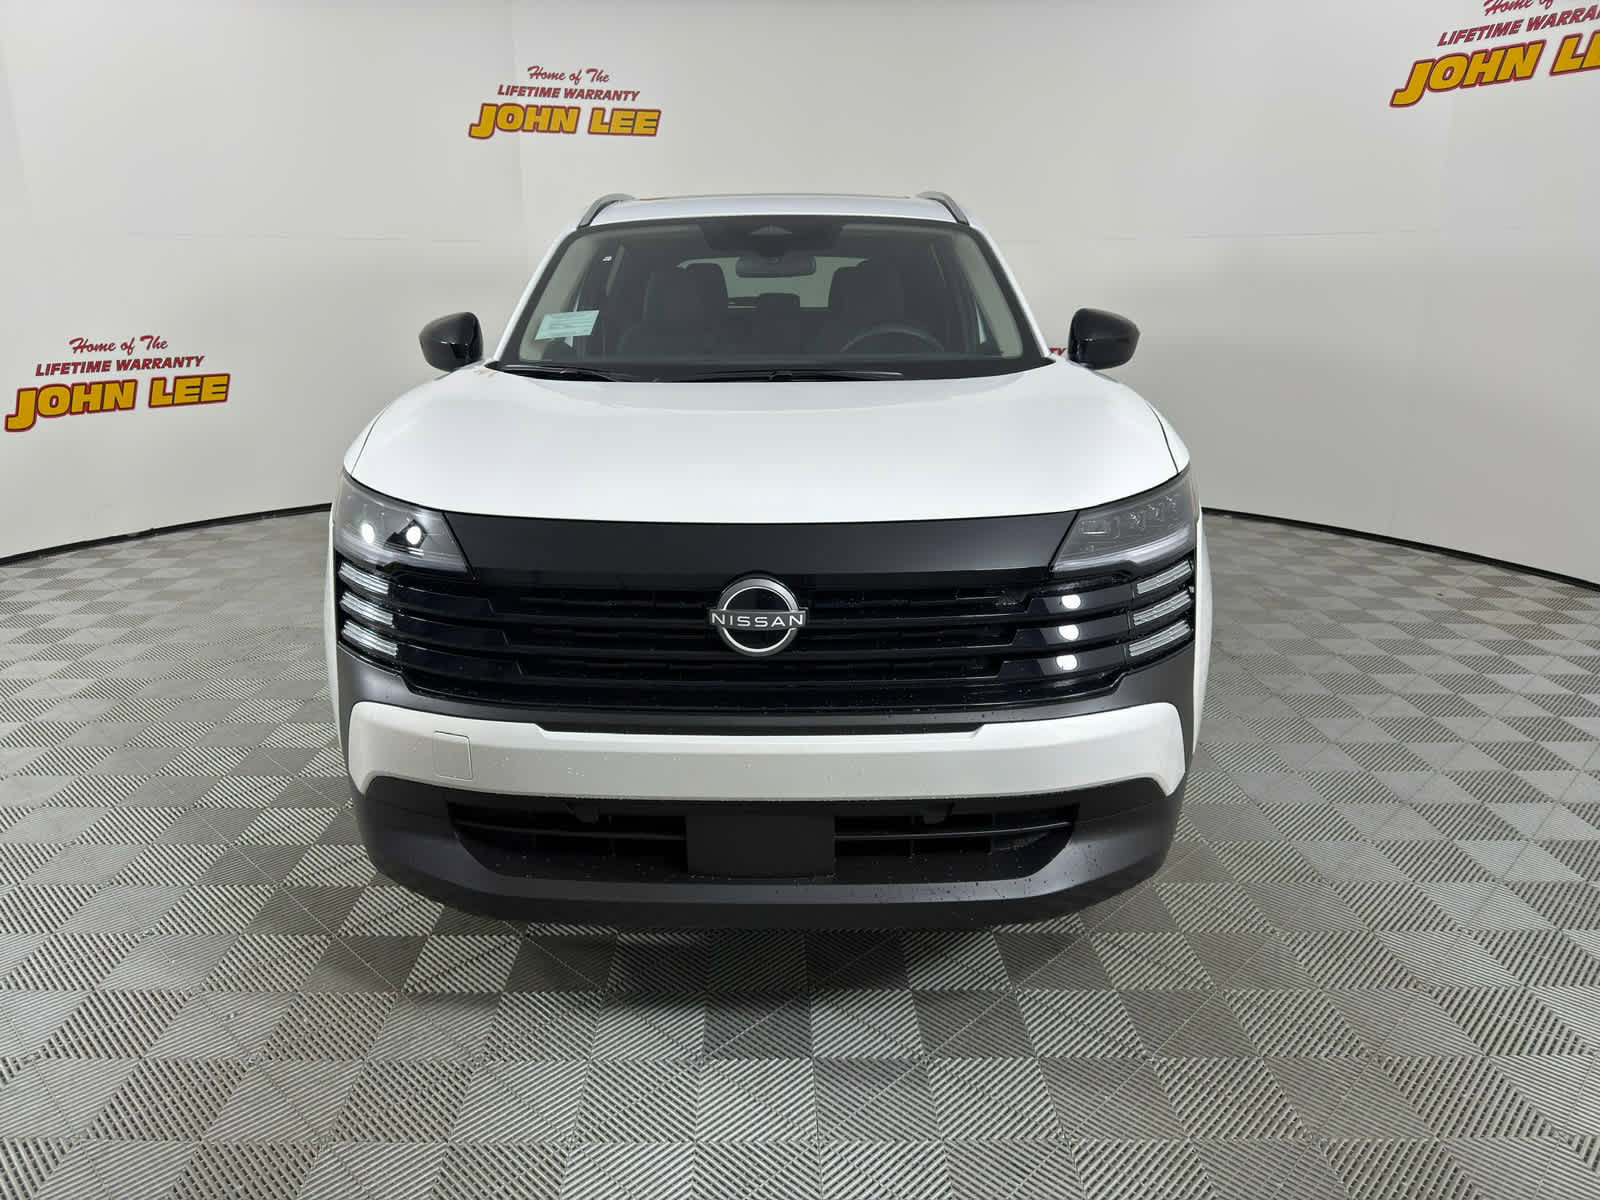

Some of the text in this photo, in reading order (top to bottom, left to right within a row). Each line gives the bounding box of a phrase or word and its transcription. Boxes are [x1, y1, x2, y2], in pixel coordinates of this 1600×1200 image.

[1437, 5, 1600, 47] LIFETIME WARRA
[527, 65, 610, 85] Home of The
[1389, 40, 1547, 108] JOHN
[497, 84, 640, 102] LIFETIME WARRANTY
[468, 103, 662, 140] JOHN LEE
[68, 335, 168, 355] Home of The
[35, 355, 205, 377] LIFETIME WARRANTY
[4, 373, 231, 432] JOHN LEE
[711, 612, 803, 628] NISSAN
